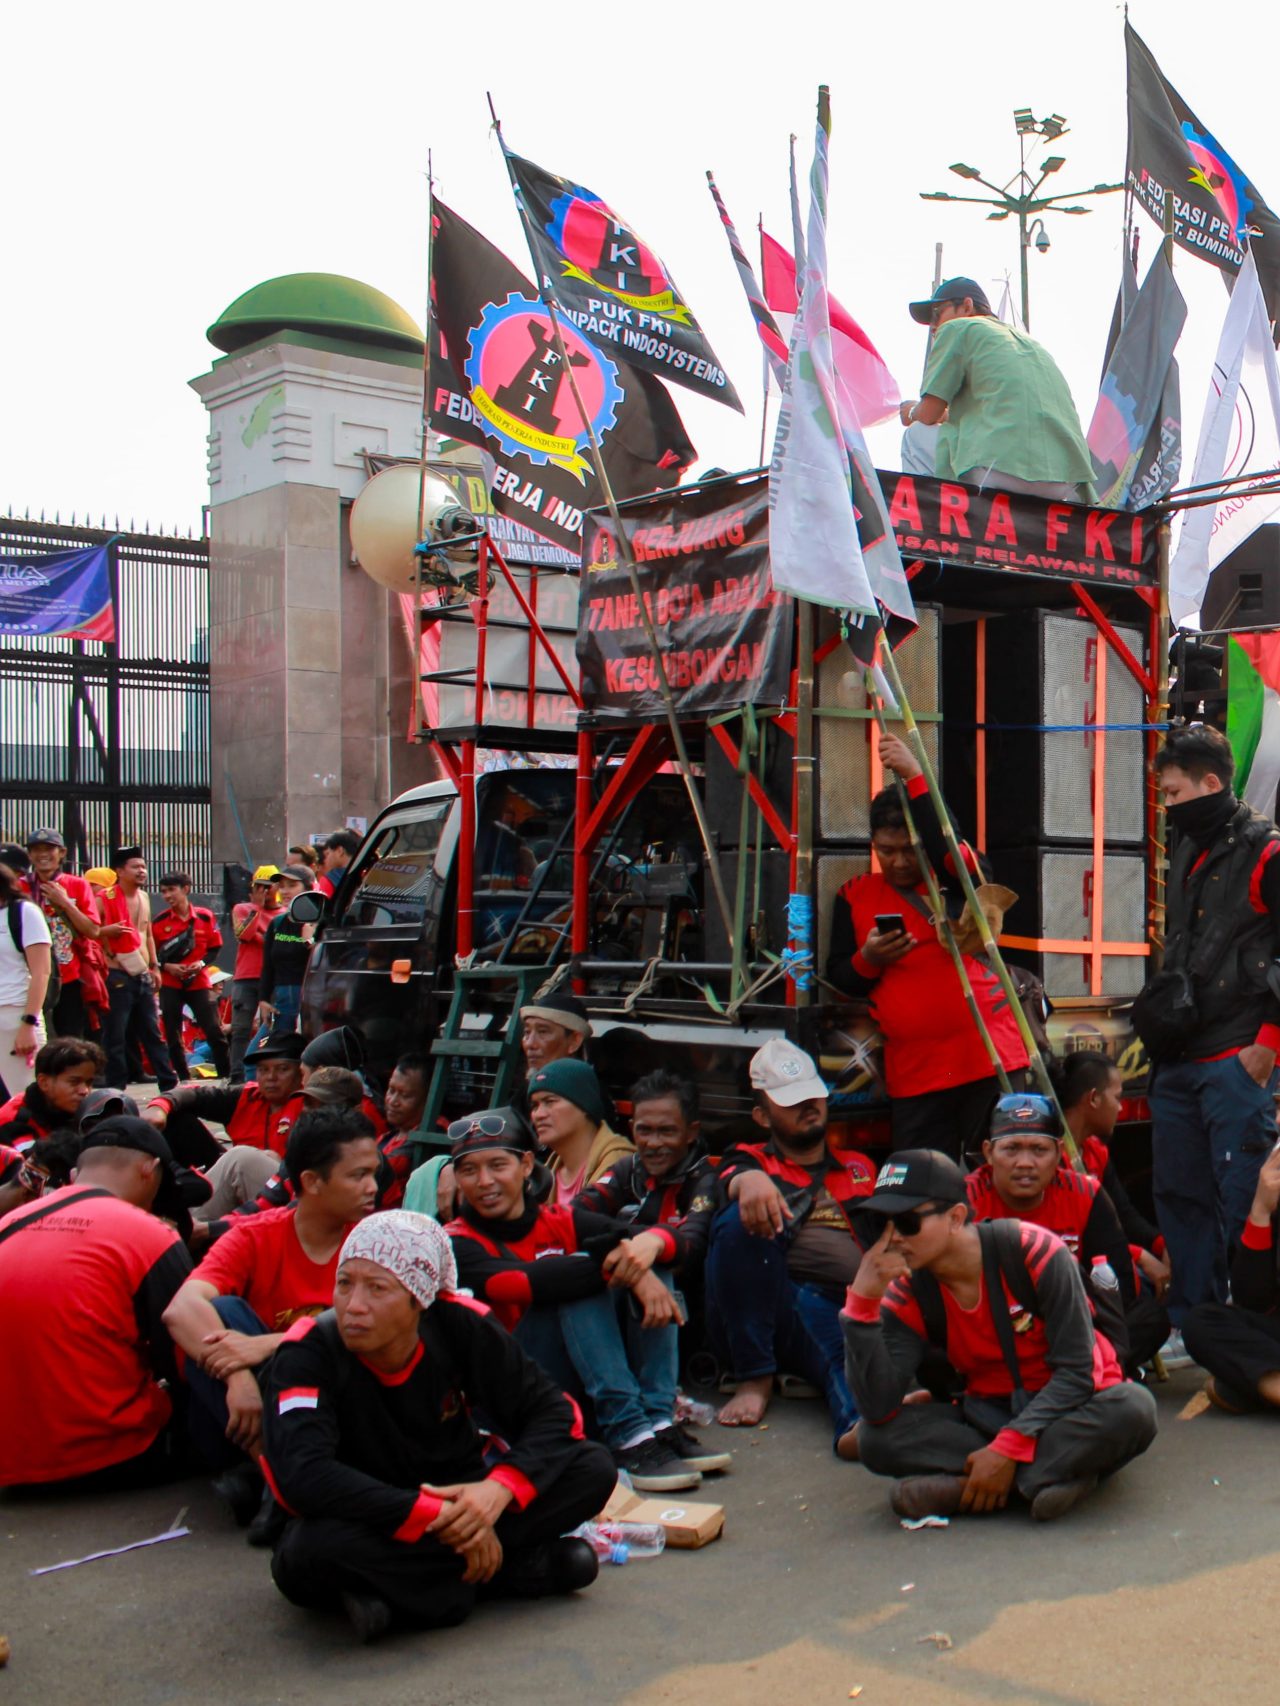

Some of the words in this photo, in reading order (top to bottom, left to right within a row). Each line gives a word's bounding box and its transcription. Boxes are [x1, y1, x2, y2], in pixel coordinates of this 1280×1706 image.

[1128, 170, 1146, 200] PUK
[1148, 198, 1164, 220] FKI
[1141, 168, 1207, 228] FEDRASI
[588, 299, 632, 325] PUK
[639, 313, 672, 338] FKI
[624, 328, 726, 387] INDOSYSTEMS
[534, 437, 570, 451] INDUSTRI
[632, 510, 746, 562] BERJUANG
[1046, 503, 1144, 565] FKI
[975, 545, 1097, 576] RELAWAN
[1102, 566, 1141, 582] FKI
